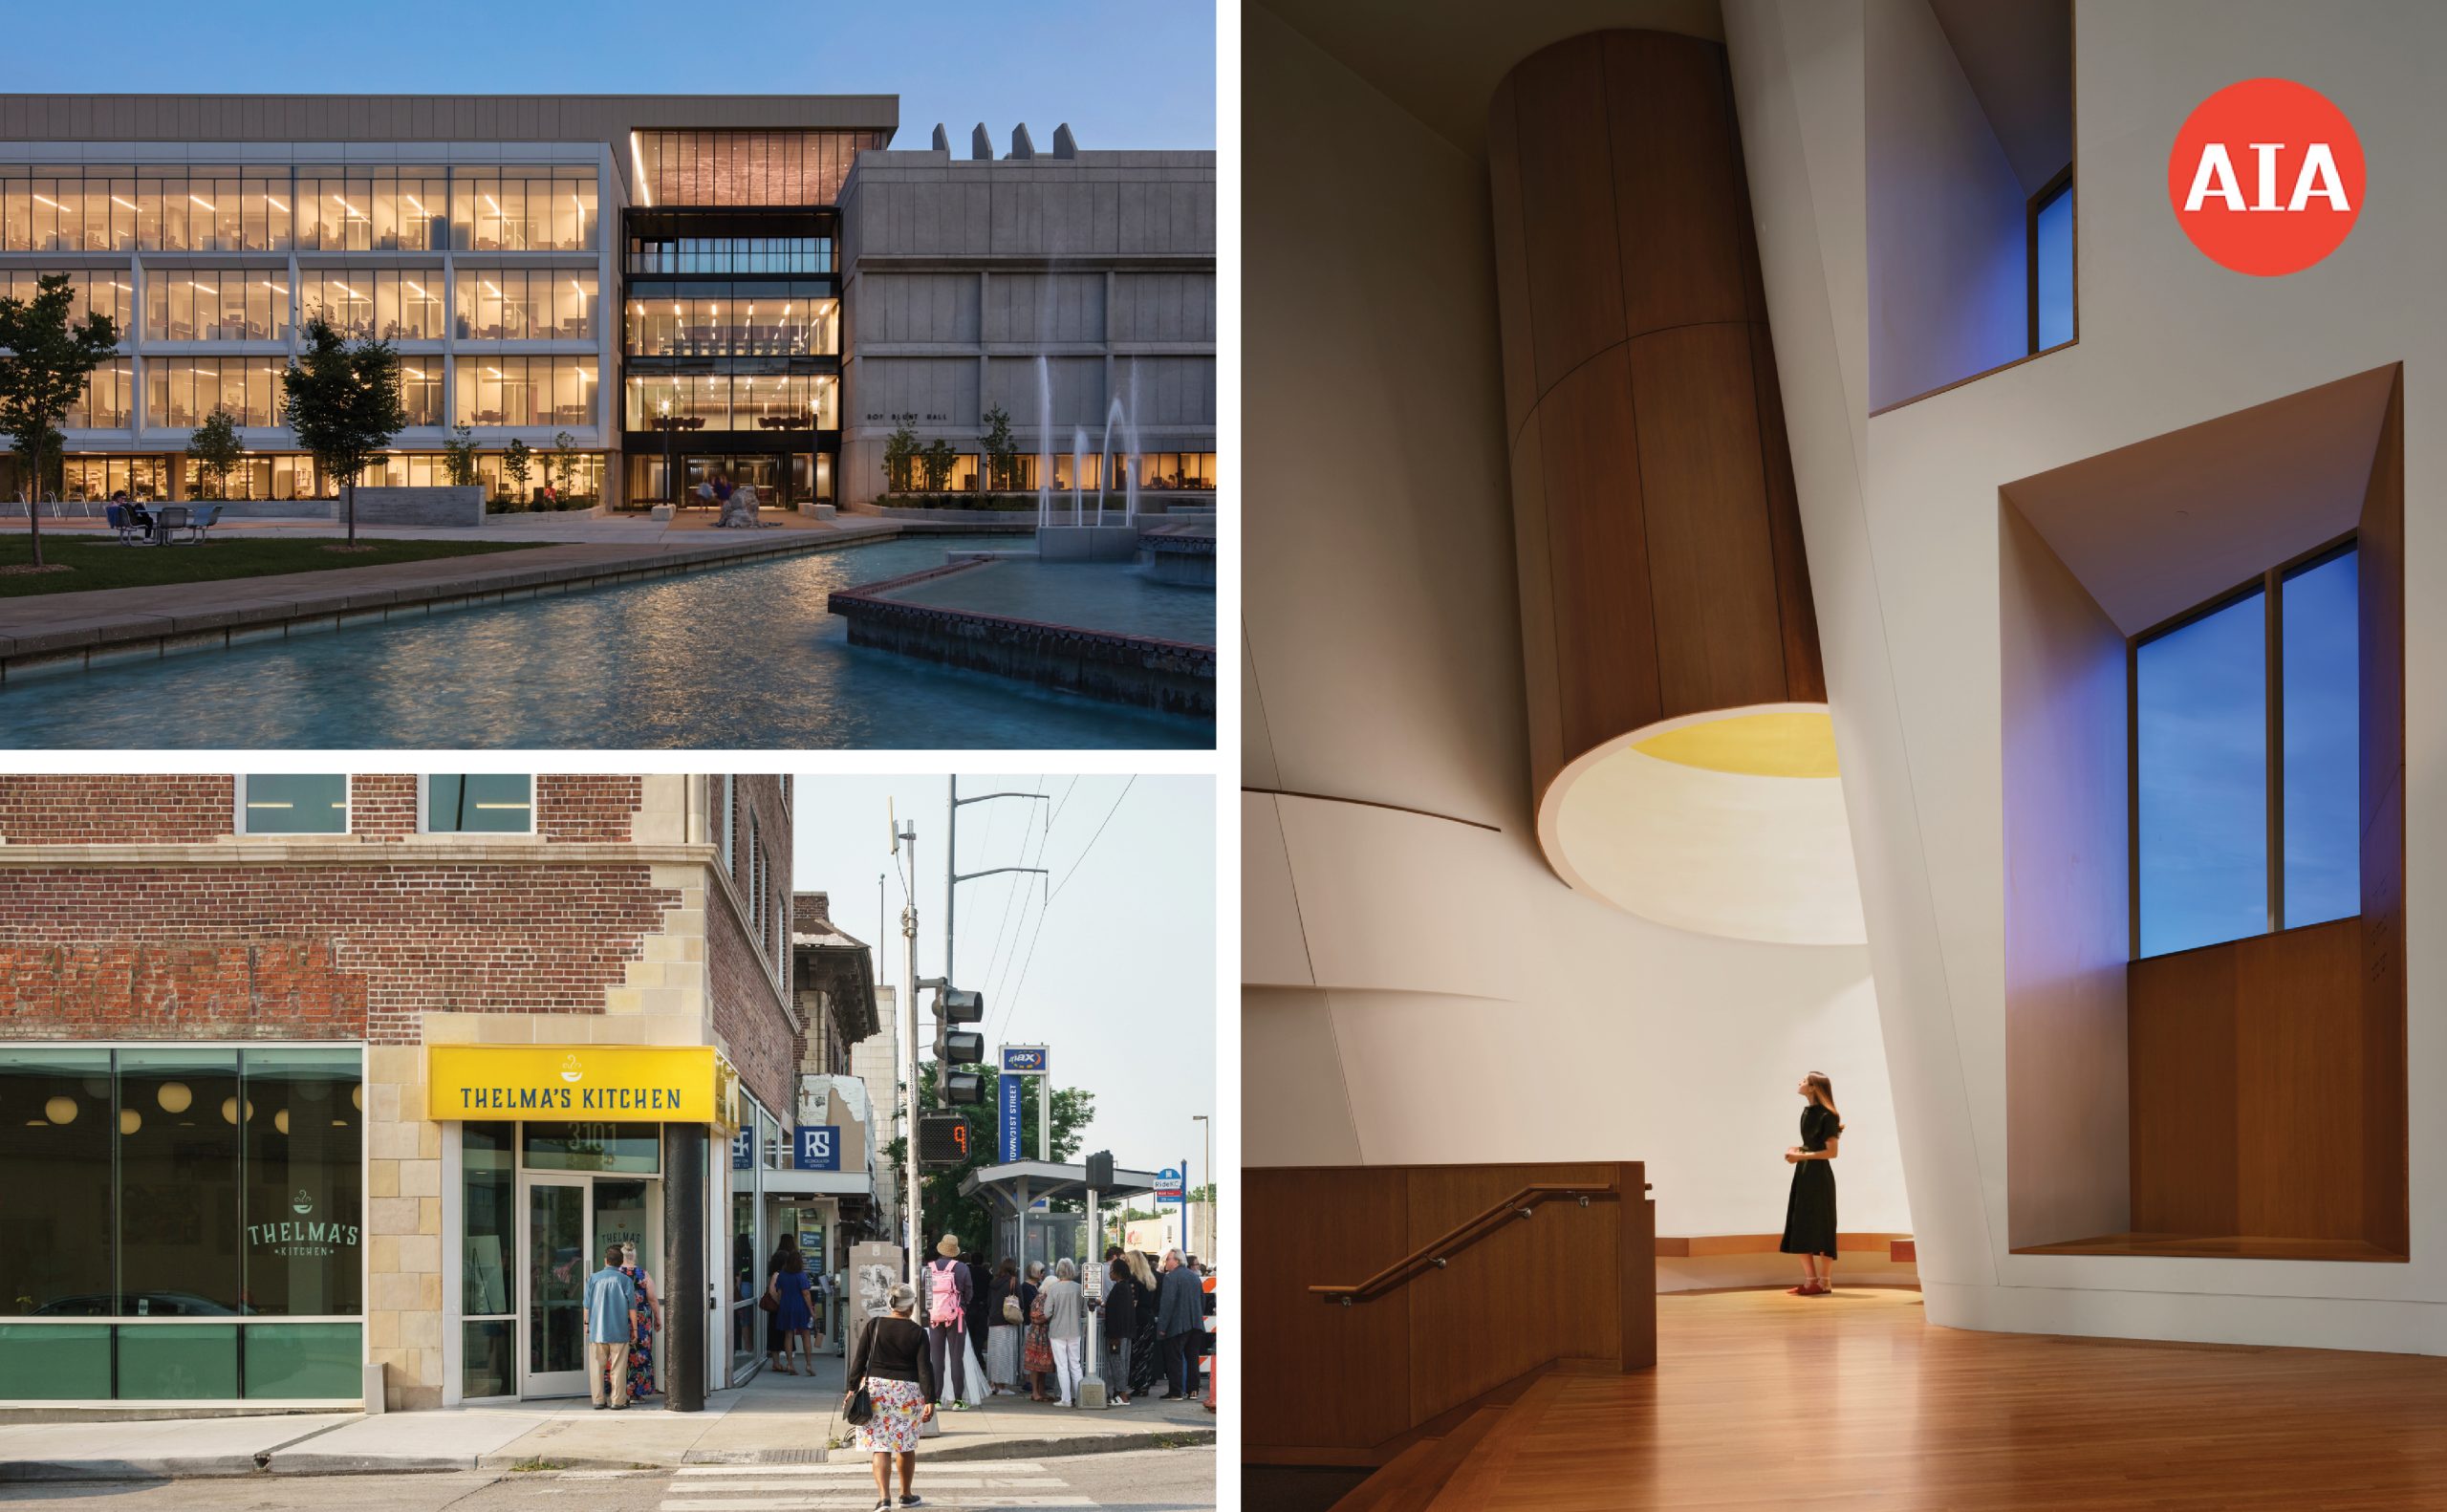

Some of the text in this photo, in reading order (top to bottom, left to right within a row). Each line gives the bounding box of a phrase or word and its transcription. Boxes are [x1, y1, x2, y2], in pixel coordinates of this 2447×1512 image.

[461, 1088, 681, 1110] THELMA'S KITCHEN
[567, 1121, 617, 1152] 3101
[804, 1131, 830, 1157] RS
[954, 1126, 965, 1156] 9
[248, 1221, 358, 1245] THELMA'S
[281, 1246, 327, 1256] KITCHEN
